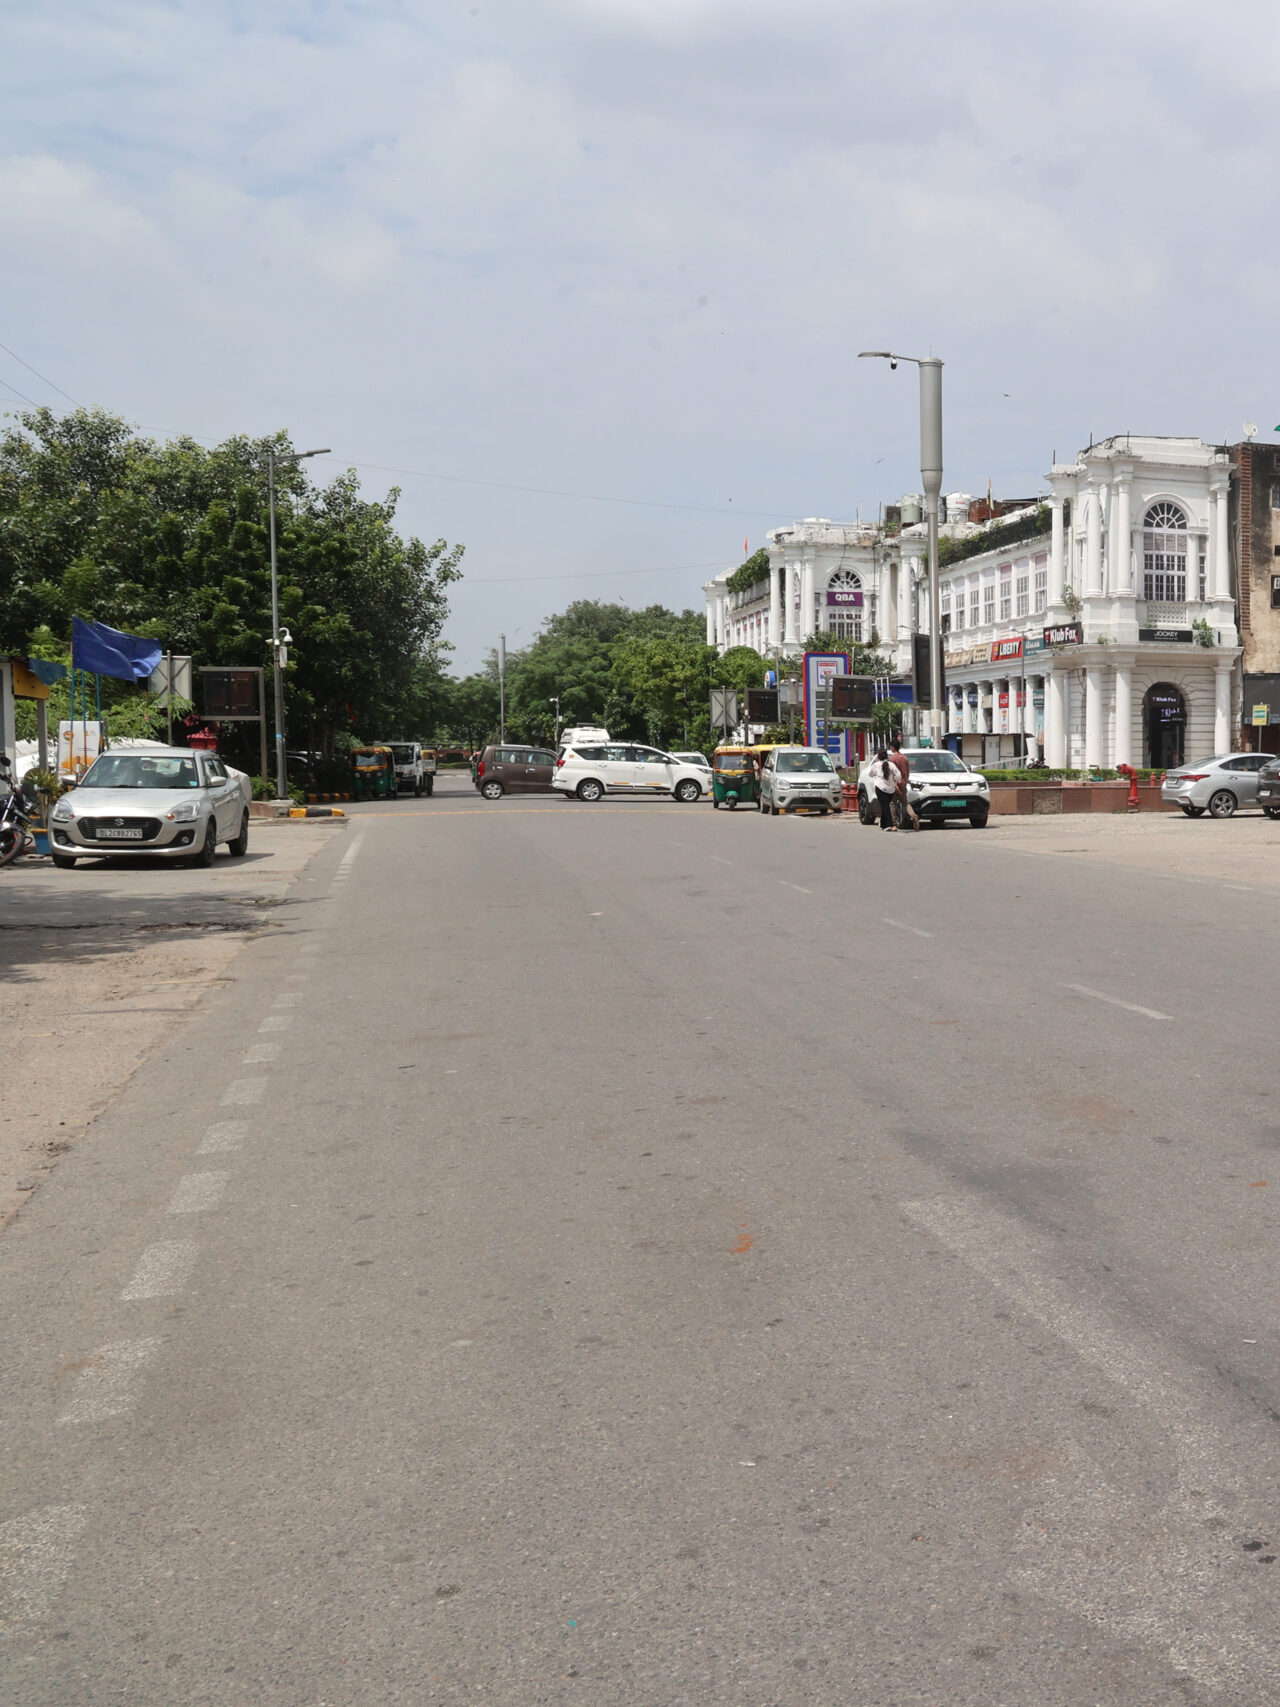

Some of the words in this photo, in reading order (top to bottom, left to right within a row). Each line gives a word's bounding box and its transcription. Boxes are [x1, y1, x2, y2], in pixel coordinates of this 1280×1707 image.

[835, 593, 856, 602] QBA
[1050, 628, 1064, 642] Klub
[1065, 627, 1077, 640] Fox
[1000, 641, 1020, 656] LIBERTY
